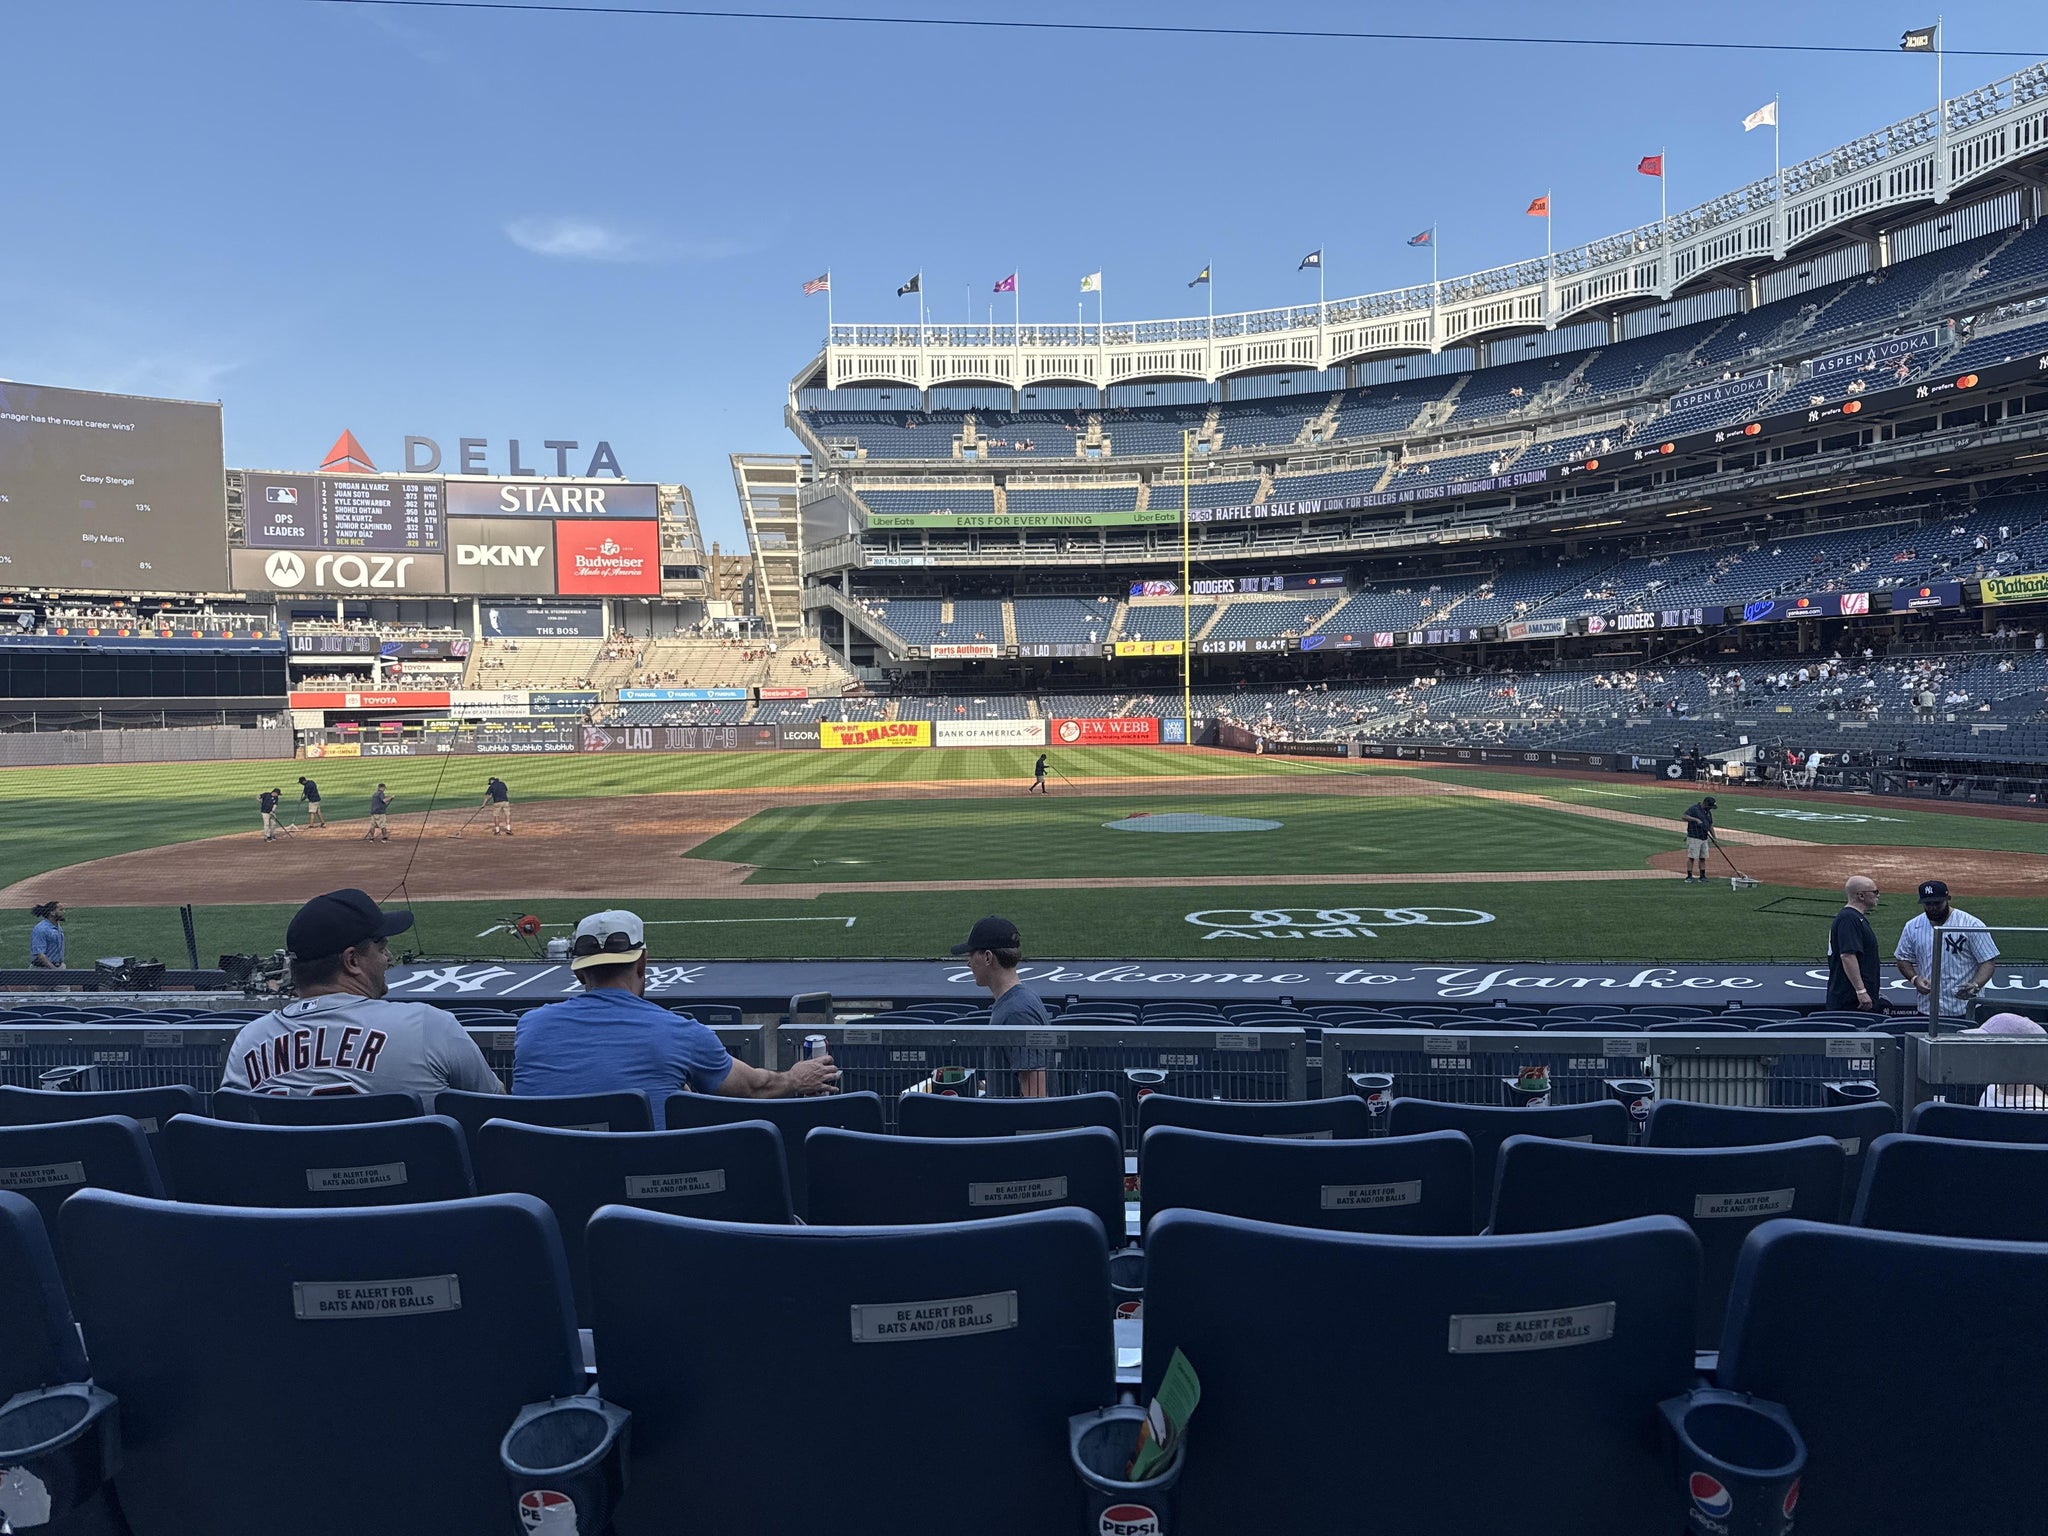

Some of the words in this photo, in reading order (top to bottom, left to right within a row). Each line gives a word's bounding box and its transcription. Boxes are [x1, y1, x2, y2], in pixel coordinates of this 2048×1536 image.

[1819, 353, 1862, 373] ASPEN
[1880, 335, 1930, 357] VODKA
[1675, 393, 1710, 409] ASPEN
[1724, 377, 1764, 397] VODKA
[1931, 383, 1954, 393] prefers
[1821, 407, 1841, 417] prefers
[30, 414, 46, 423] has
[48, 416, 61, 425] the
[63, 418, 83, 427] most
[85, 421, 110, 430] career
[112, 422, 135, 431] wins?
[1726, 429, 1744, 438] prefers
[404, 435, 624, 478] DELTA
[80, 474, 104, 485] Casey
[106, 475, 135, 487] Stengel
[334, 482, 360, 490] YORDAN
[361, 483, 390, 491] ALVAREZ
[500, 485, 607, 513] STARR
[1216, 506, 1251, 520] RAFFLE
[1254, 505, 1268, 517] ON
[1271, 503, 1295, 516] SALE
[1298, 501, 1321, 514] NOW
[1324, 499, 1344, 511] LOOK
[1346, 497, 1361, 508] FOR
[1363, 493, 1396, 507] SELLERS
[1399, 491, 1414, 502] AND
[1416, 486, 1444, 500] KIOSKS
[1447, 479, 1495, 497] THROUGHOUT
[1498, 476, 1511, 488] THE
[1513, 470, 1547, 486] STADIUM
[136, 503, 151, 511] 13%
[335, 498, 351, 506] KYLE
[353, 499, 391, 507] SCHWARBER
[359, 507, 382, 515] OHTANI
[275, 514, 293, 524] OPS
[335, 514, 350, 522] NICK
[873, 518, 893, 526] Uber
[957, 517, 984, 526] EATS
[988, 517, 1010, 525] FOR
[1013, 516, 1048, 525] EVERY
[1052, 516, 1092, 525] INNING
[1134, 514, 1154, 522] Uber
[1155, 513, 1175, 521] Eats
[264, 526, 305, 537] LEADERS
[335, 522, 359, 530] JUNIOR
[360, 523, 392, 531] CAMINERO
[82, 533, 99, 544] Billy
[100, 535, 125, 543] Martin
[336, 530, 357, 538] YANDY
[457, 544, 546, 566] DKNY
[575, 555, 644, 568] Budweiser
[315, 554, 414, 588] razr
[574, 568, 600, 576] Made
[609, 568, 642, 576] America
[1193, 580, 1235, 594] DODGERS
[1909, 598, 1941, 607] yankees.com
[1617, 612, 1655, 630] DODGERS
[1661, 610, 1680, 628] JULY
[1682, 608, 1703, 625] 17-19
[1788, 609, 1821, 618] yankees.com
[1528, 623, 1561, 634] AMAZING
[1408, 631, 1422, 644] LAD
[292, 637, 312, 651] LAD
[320, 637, 343, 651] JULY
[345, 637, 370, 651] 17-19
[934, 647, 955, 655] Parts
[956, 644, 994, 655] Authority
[1202, 641, 1226, 653] 6:13
[1229, 640, 1246, 652] PM
[1034, 645, 1050, 656] LAD
[761, 689, 789, 697] Reebok
[1082, 722, 1106, 733] F.W.
[1109, 722, 1149, 733] WEBB
[625, 728, 653, 749] LAD
[665, 728, 698, 749] JULY
[703, 728, 738, 748] 17-19
[784, 732, 820, 740] LEGORA
[371, 745, 408, 755] STARR
[477, 744, 509, 752] StubHub
[545, 743, 575, 751] StubHub
[1201, 927, 1379, 940] Audi
[943, 965, 1310, 985] Welcome
[1325, 968, 1416, 985] to
[1412, 967, 1763, 997] Yankee
[243, 1025, 388, 1091] DINGLER
[1003, 1192, 1030, 1200] AND/OR
[1032, 1189, 1053, 1197] BALLS
[1006, 1185, 1027, 1193] ALERT
[337, 1289, 351, 1299] BE
[355, 1288, 389, 1298] ALERT
[392, 1286, 414, 1296] FOR
[319, 1301, 348, 1311] BATS
[351, 1299, 397, 1310] AND/OR
[399, 1295, 434, 1308] BALLS
[897, 1311, 912, 1321] BE
[915, 1307, 949, 1319] ALERT
[952, 1304, 974, 1316] FOR
[878, 1323, 907, 1334] BATS
[909, 1318, 956, 1332] AND/OR
[959, 1314, 993, 1326] BALLS
[1496, 1322, 1512, 1332] BE
[1515, 1319, 1550, 1331] ALERT
[1552, 1316, 1573, 1326] FOR
[1475, 1334, 1505, 1345] BATS
[1507, 1331, 1555, 1344] AND/OR
[1557, 1325, 1591, 1339] BALLS
[1103, 1521, 1155, 1536] PEPSI
